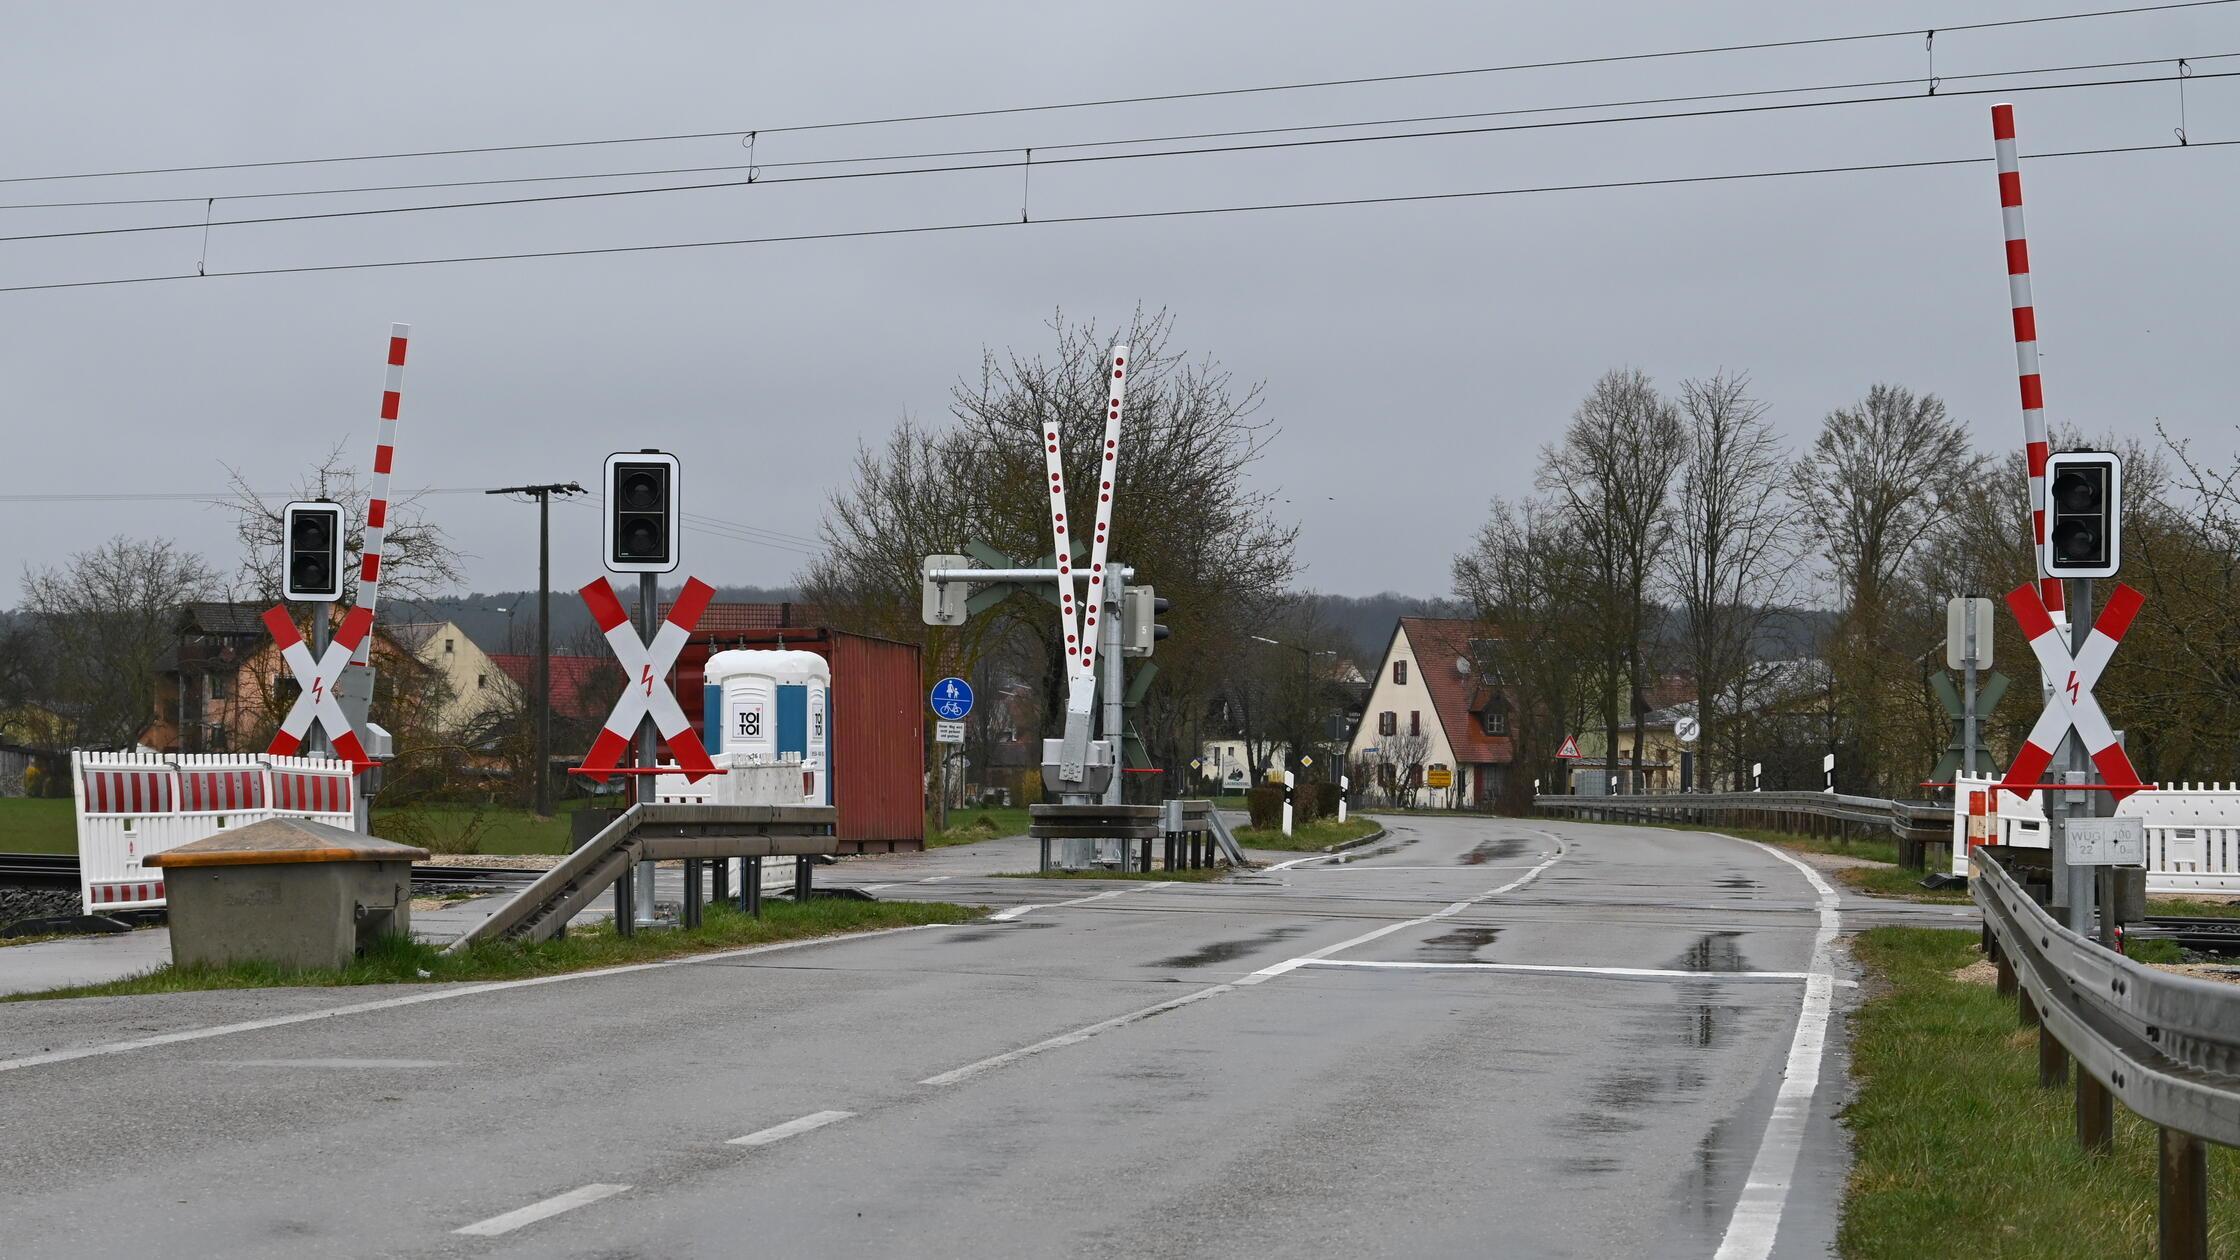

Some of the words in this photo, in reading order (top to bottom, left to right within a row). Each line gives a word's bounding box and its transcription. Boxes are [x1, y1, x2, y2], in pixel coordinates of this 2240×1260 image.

[1142, 625, 1147, 634] 5
[739, 712, 760, 724] TOI
[739, 724, 760, 735] TOI
[1680, 722, 1696, 736] 50
[2071, 831, 2101, 841] WUG
[2080, 845, 2093, 855] 22
